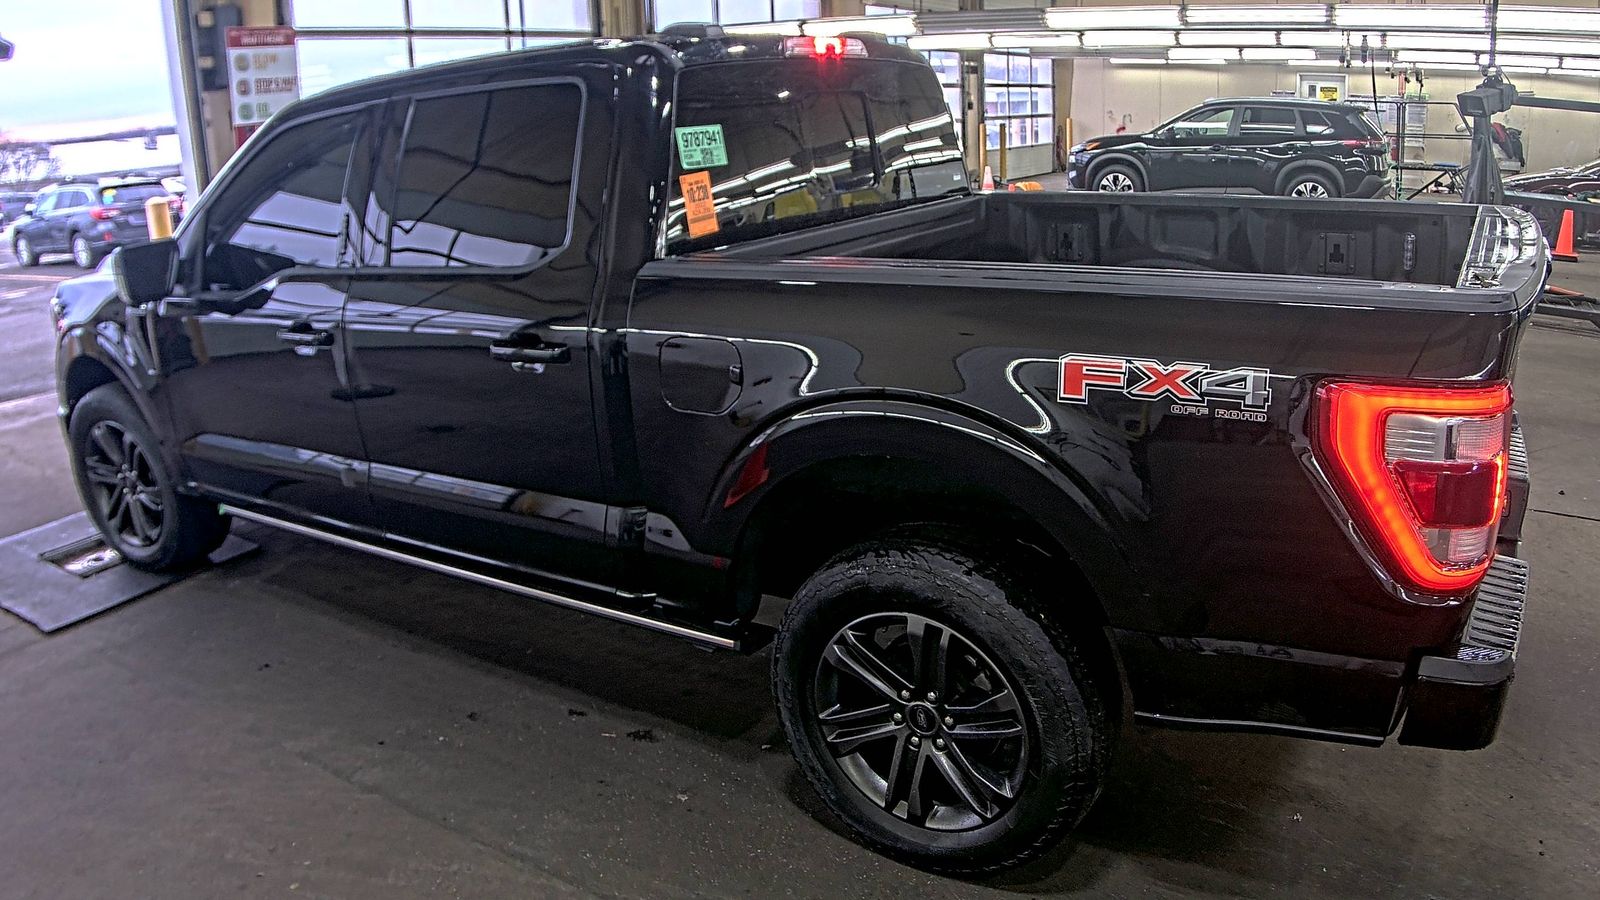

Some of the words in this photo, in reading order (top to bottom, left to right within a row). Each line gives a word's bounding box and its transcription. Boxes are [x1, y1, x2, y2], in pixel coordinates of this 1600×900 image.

[255, 78, 273, 89] STOP
[681, 130, 722, 149] 9787941
[1057, 353, 1272, 411] FX4
[1171, 405, 1209, 416] OFF
[1215, 409, 1268, 422] ROAD
